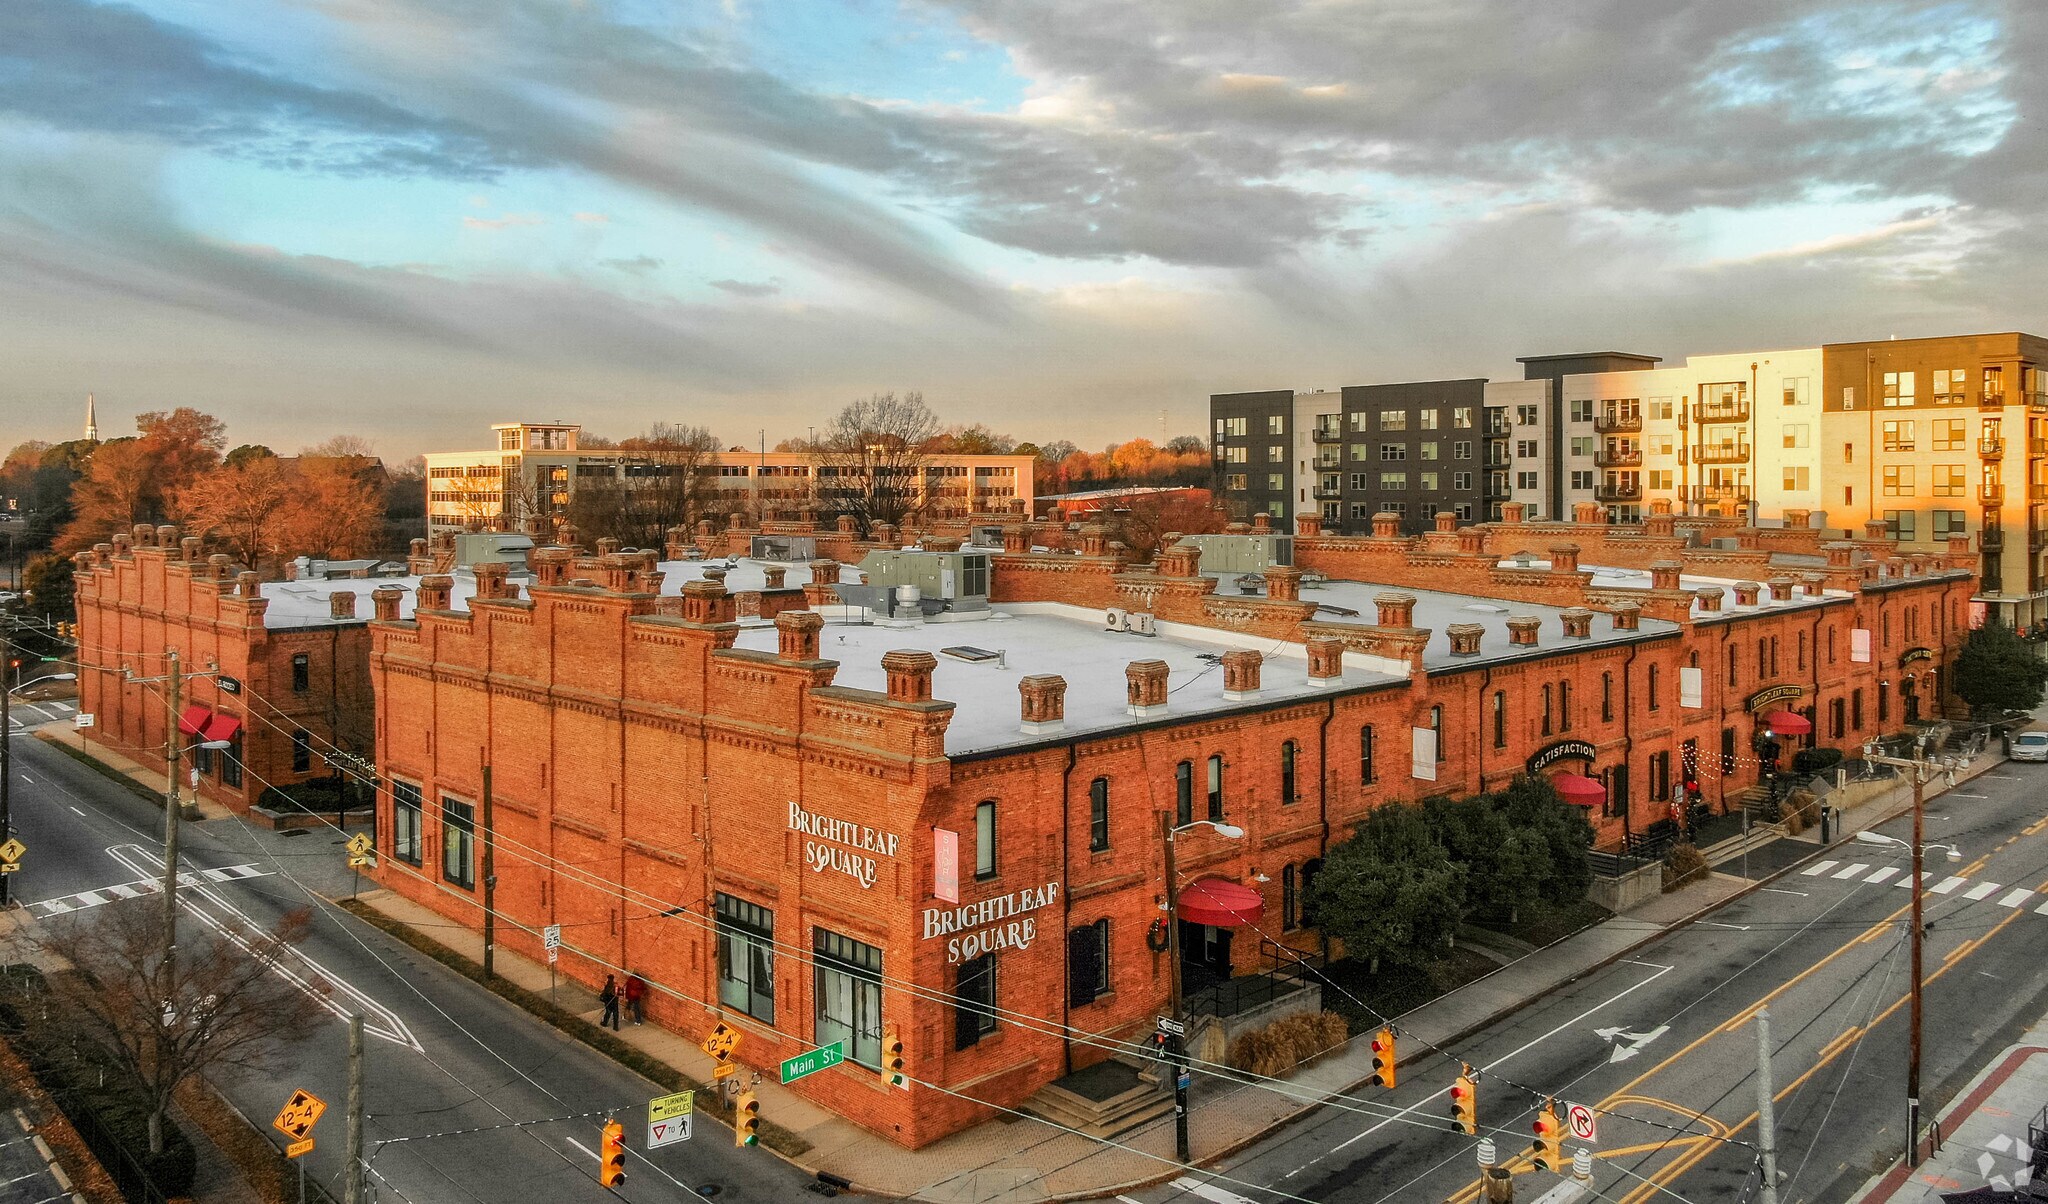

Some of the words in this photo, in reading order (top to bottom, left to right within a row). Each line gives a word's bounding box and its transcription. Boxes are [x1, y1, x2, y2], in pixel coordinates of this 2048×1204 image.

[1534, 743, 1595, 772] SATISFACTION
[788, 801, 899, 857] BRIGHTLEAF
[806, 841, 877, 889] SQUARE
[922, 882, 1060, 940] BRIGHTLEAF
[546, 936, 559, 947] 25
[948, 918, 1036, 966] SQUARE
[790, 1058, 815, 1077] Main
[822, 1049, 835, 1064] St
[663, 1103, 690, 1115] VEHICLES
[664, 1095, 688, 1106] TURNING
[668, 1126, 676, 1134] TO
